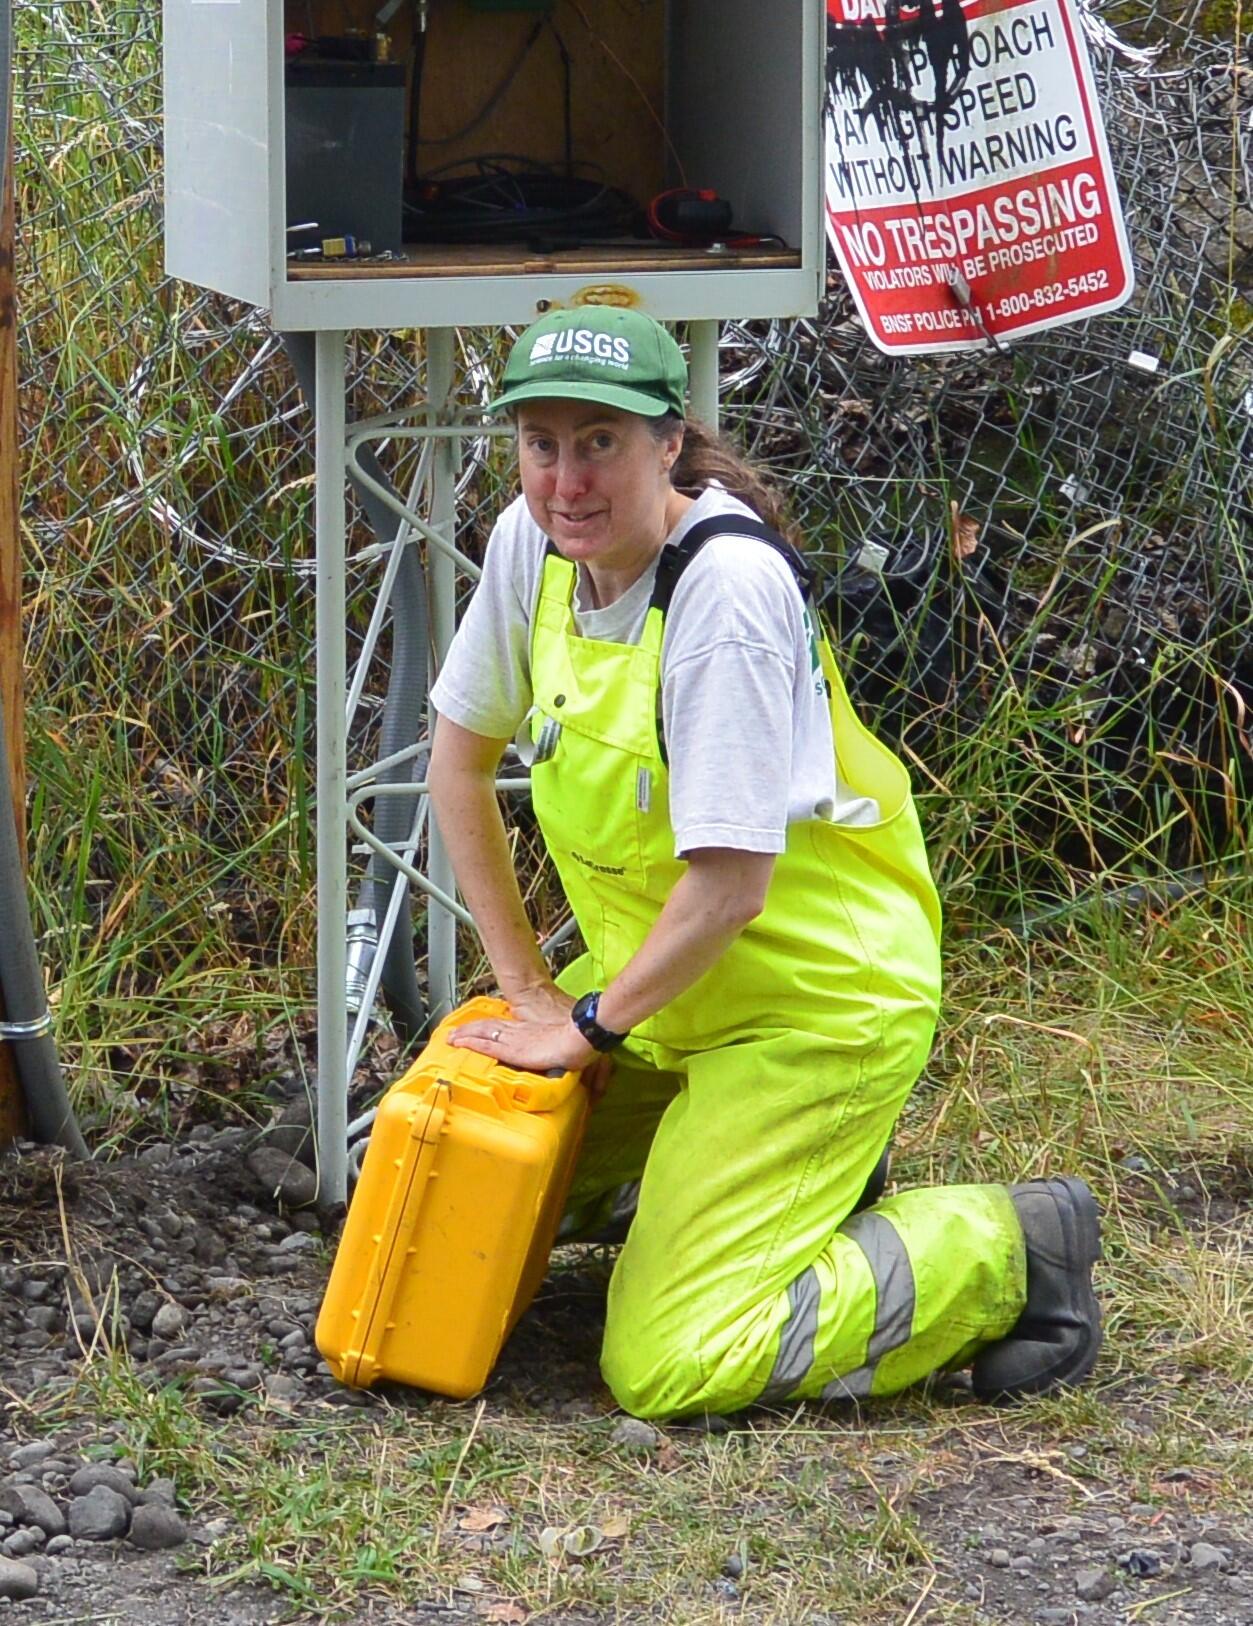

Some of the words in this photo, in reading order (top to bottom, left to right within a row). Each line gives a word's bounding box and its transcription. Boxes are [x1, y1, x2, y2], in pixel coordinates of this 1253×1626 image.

[844, 107, 868, 146] AT
[942, 72, 1036, 131] SPEED
[829, 153, 934, 198] WITHOUT
[940, 114, 1077, 185] WARNING
[841, 221, 886, 267] NO
[885, 173, 1102, 263] TRESPASSING
[862, 264, 933, 291] VIOLATORS
[963, 255, 988, 280] BE
[988, 222, 1099, 272] PROSECUTED
[880, 314, 913, 334] BNSF
[913, 308, 962, 331] POLICE
[986, 269, 1109, 321] 1-800-832-5452
[555, 328, 630, 362] USGS
